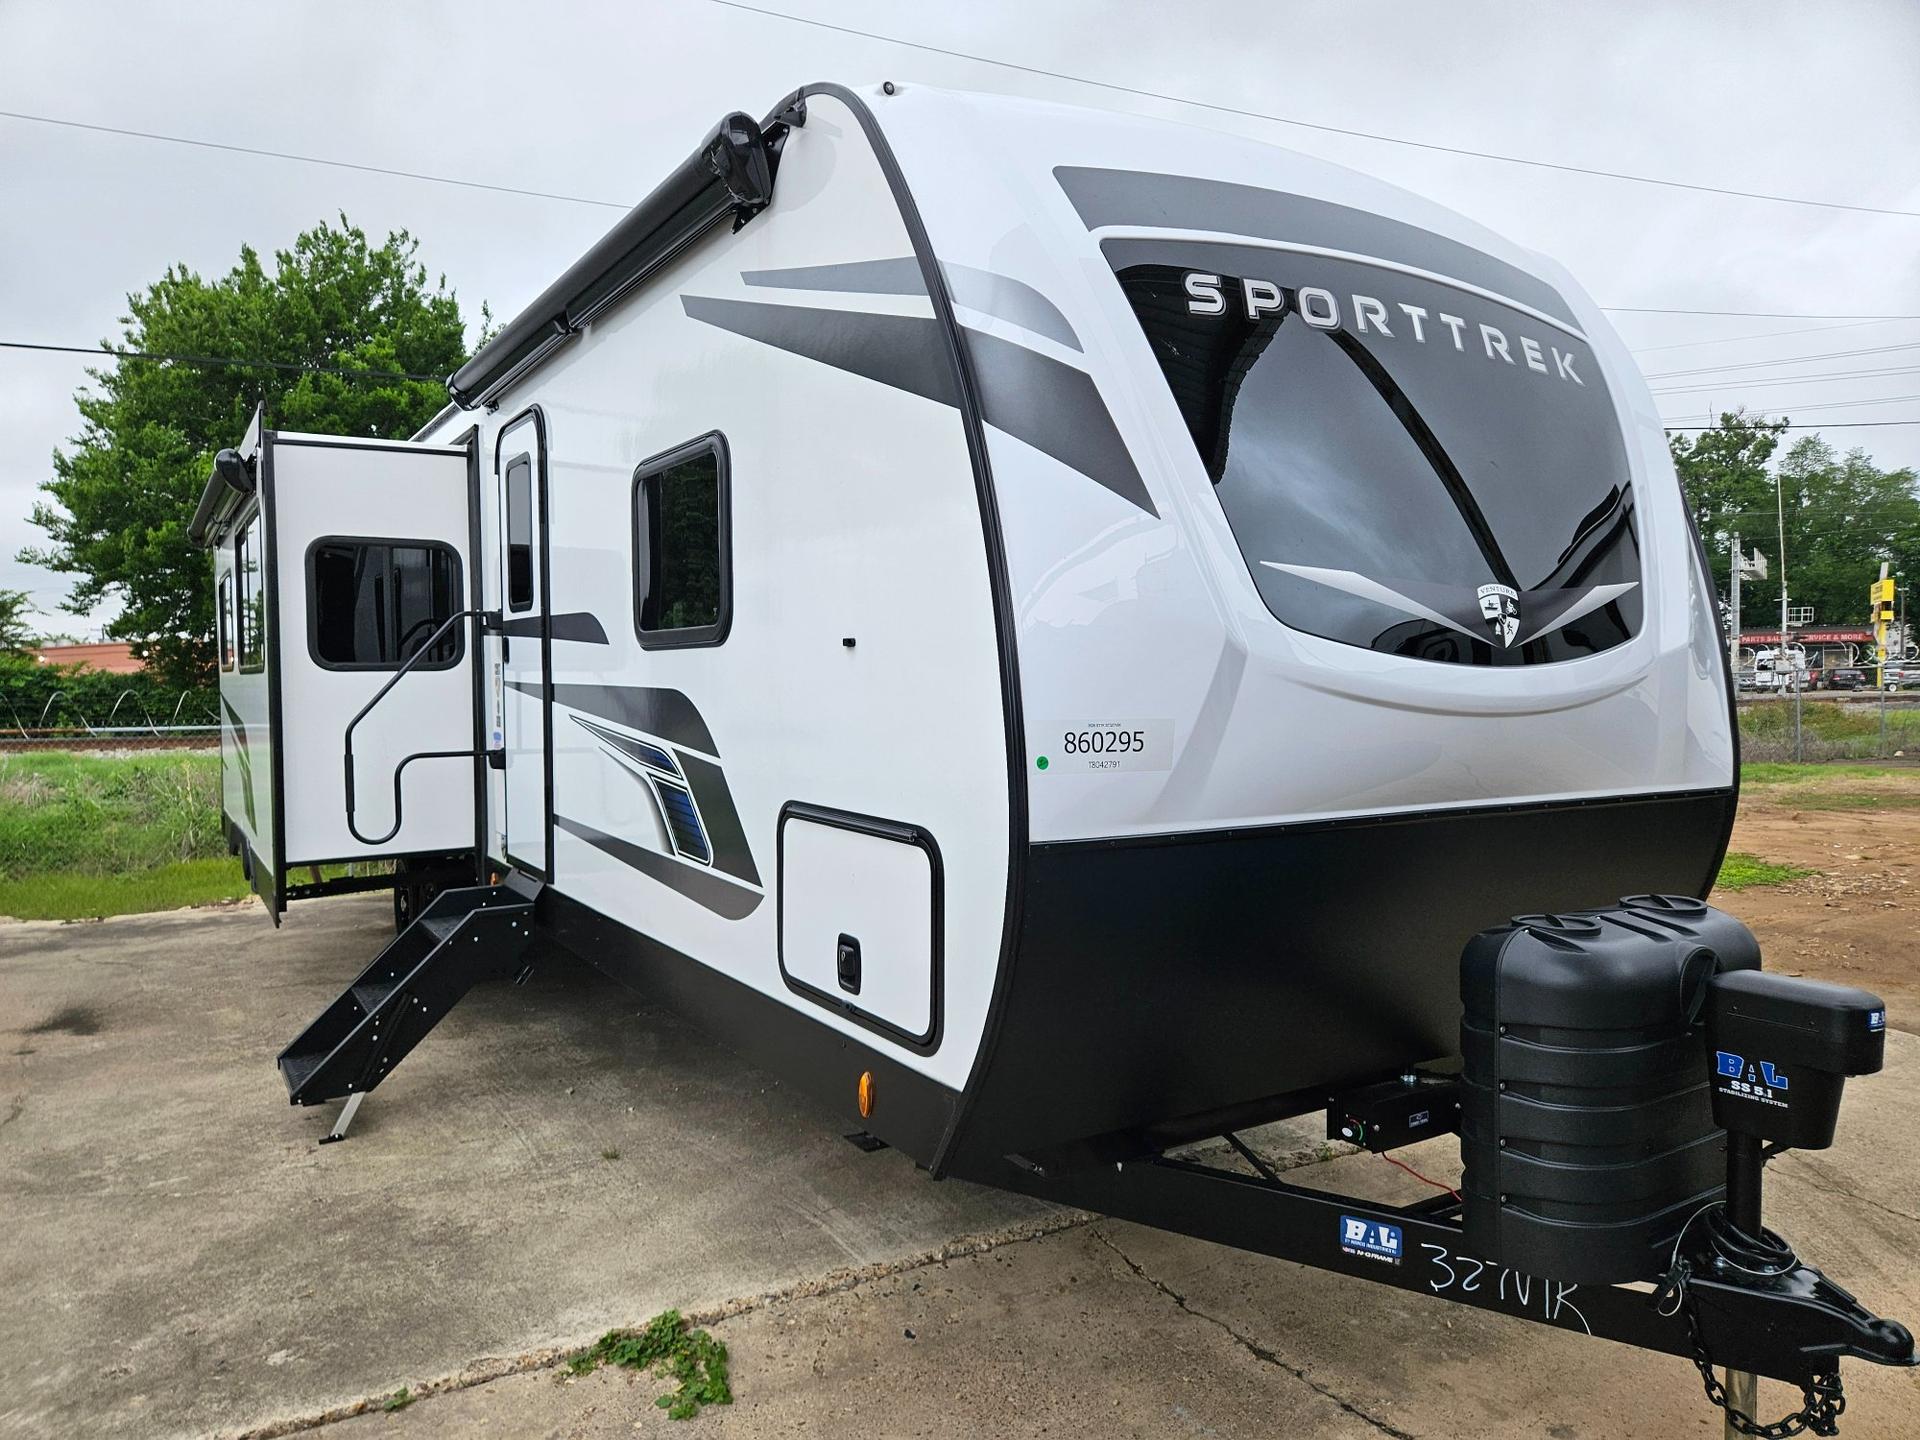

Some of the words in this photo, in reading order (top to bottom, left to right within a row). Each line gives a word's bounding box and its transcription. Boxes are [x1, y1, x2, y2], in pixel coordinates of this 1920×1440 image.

[1183, 271, 1586, 386] SPORTTREK
[1480, 586, 1515, 597] VENTURE
[1064, 731, 1145, 754] 860295
[1718, 1087, 1760, 1102] STABILIZING
[1760, 1098, 1789, 1109] SYSTEM
[1731, 1080, 1751, 1093] SS
[1754, 1086, 1773, 1099] 5.1
